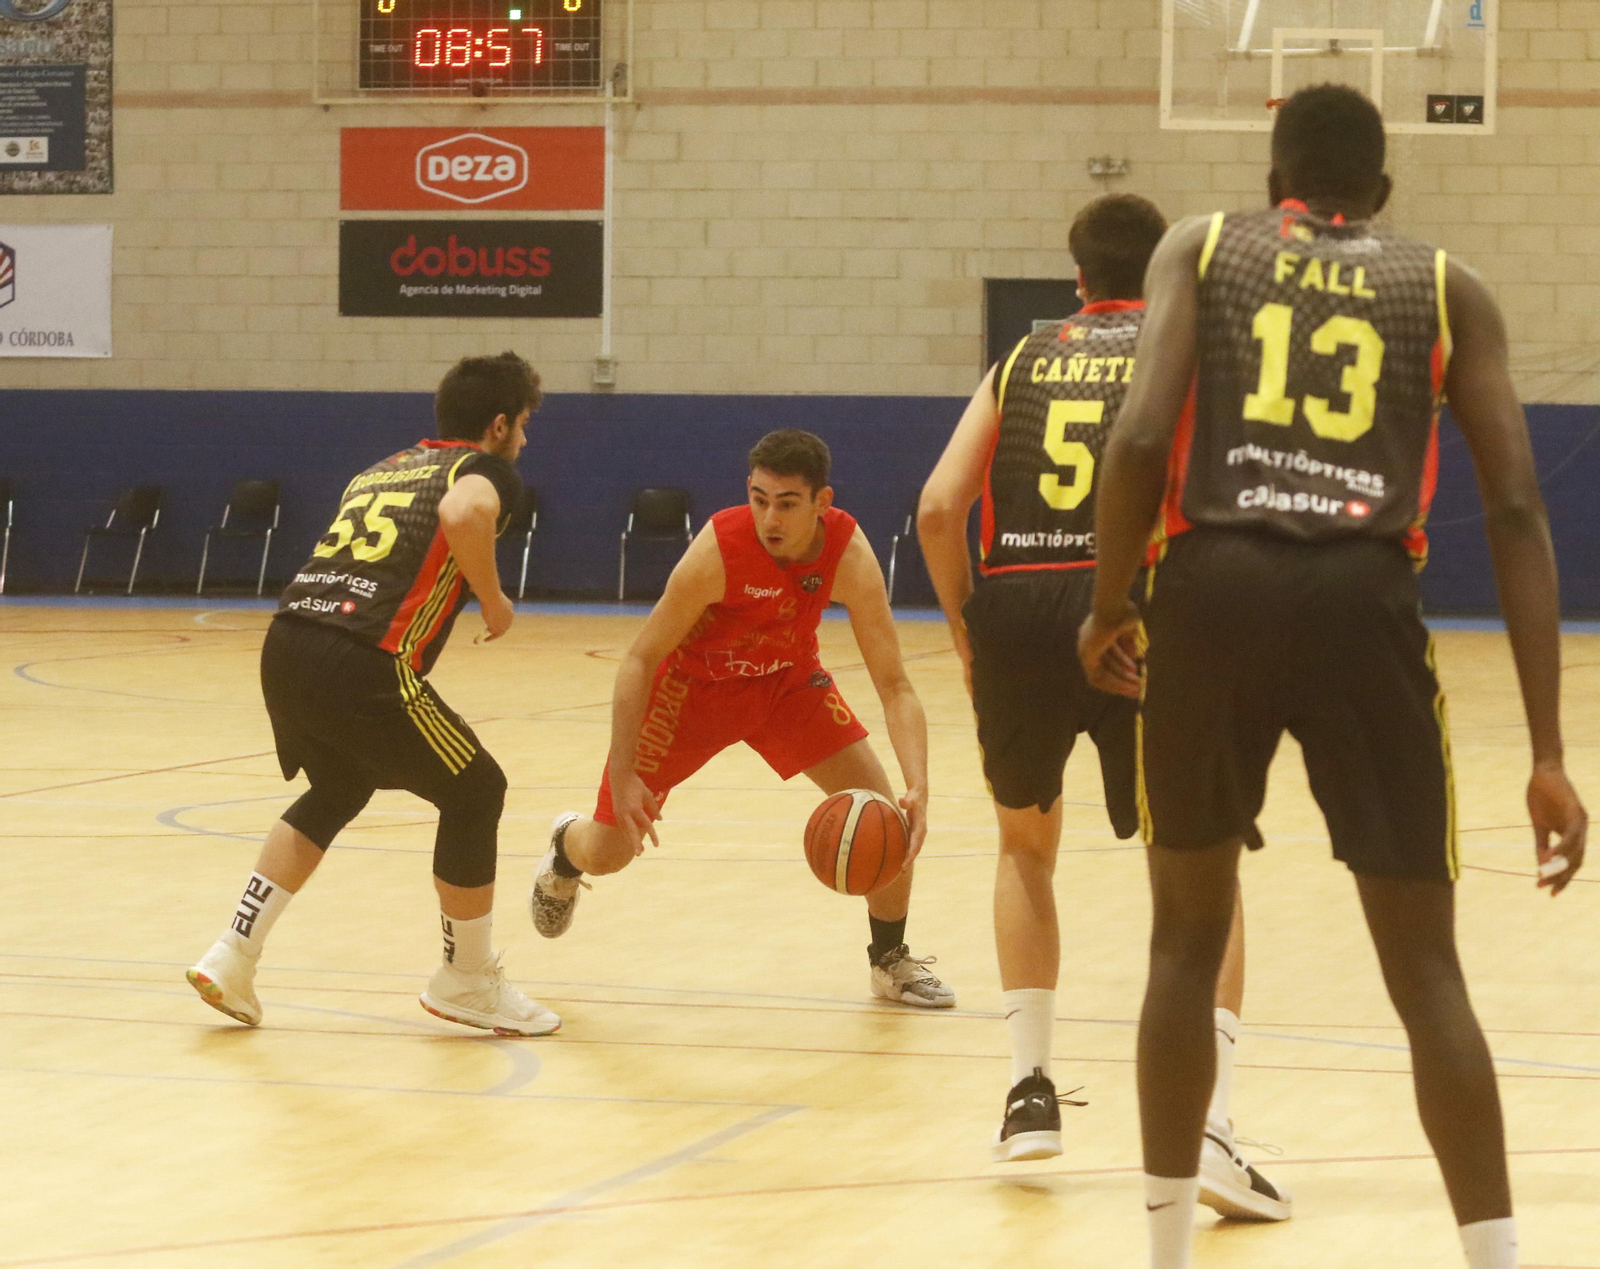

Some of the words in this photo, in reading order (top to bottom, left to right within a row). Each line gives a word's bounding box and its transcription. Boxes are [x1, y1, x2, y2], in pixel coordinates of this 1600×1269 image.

[414, 28, 542, 67] 08:57
[555, 42, 572, 51] TIME
[574, 42, 590, 51] OUT
[389, 234, 552, 278] dobuss
[1273, 251, 1377, 299] FALL
[400, 284, 439, 297] Agencia
[441, 283, 454, 295] de
[456, 284, 507, 298] Marketing
[509, 284, 542, 297] Digital
[9, 327, 75, 347] CÓRDOBA
[1242, 302, 1385, 442] 13
[1038, 400, 1105, 511] 5
[313, 491, 416, 563] 55
[824, 692, 851, 725] 8
[231, 875, 274, 939] ELITE
